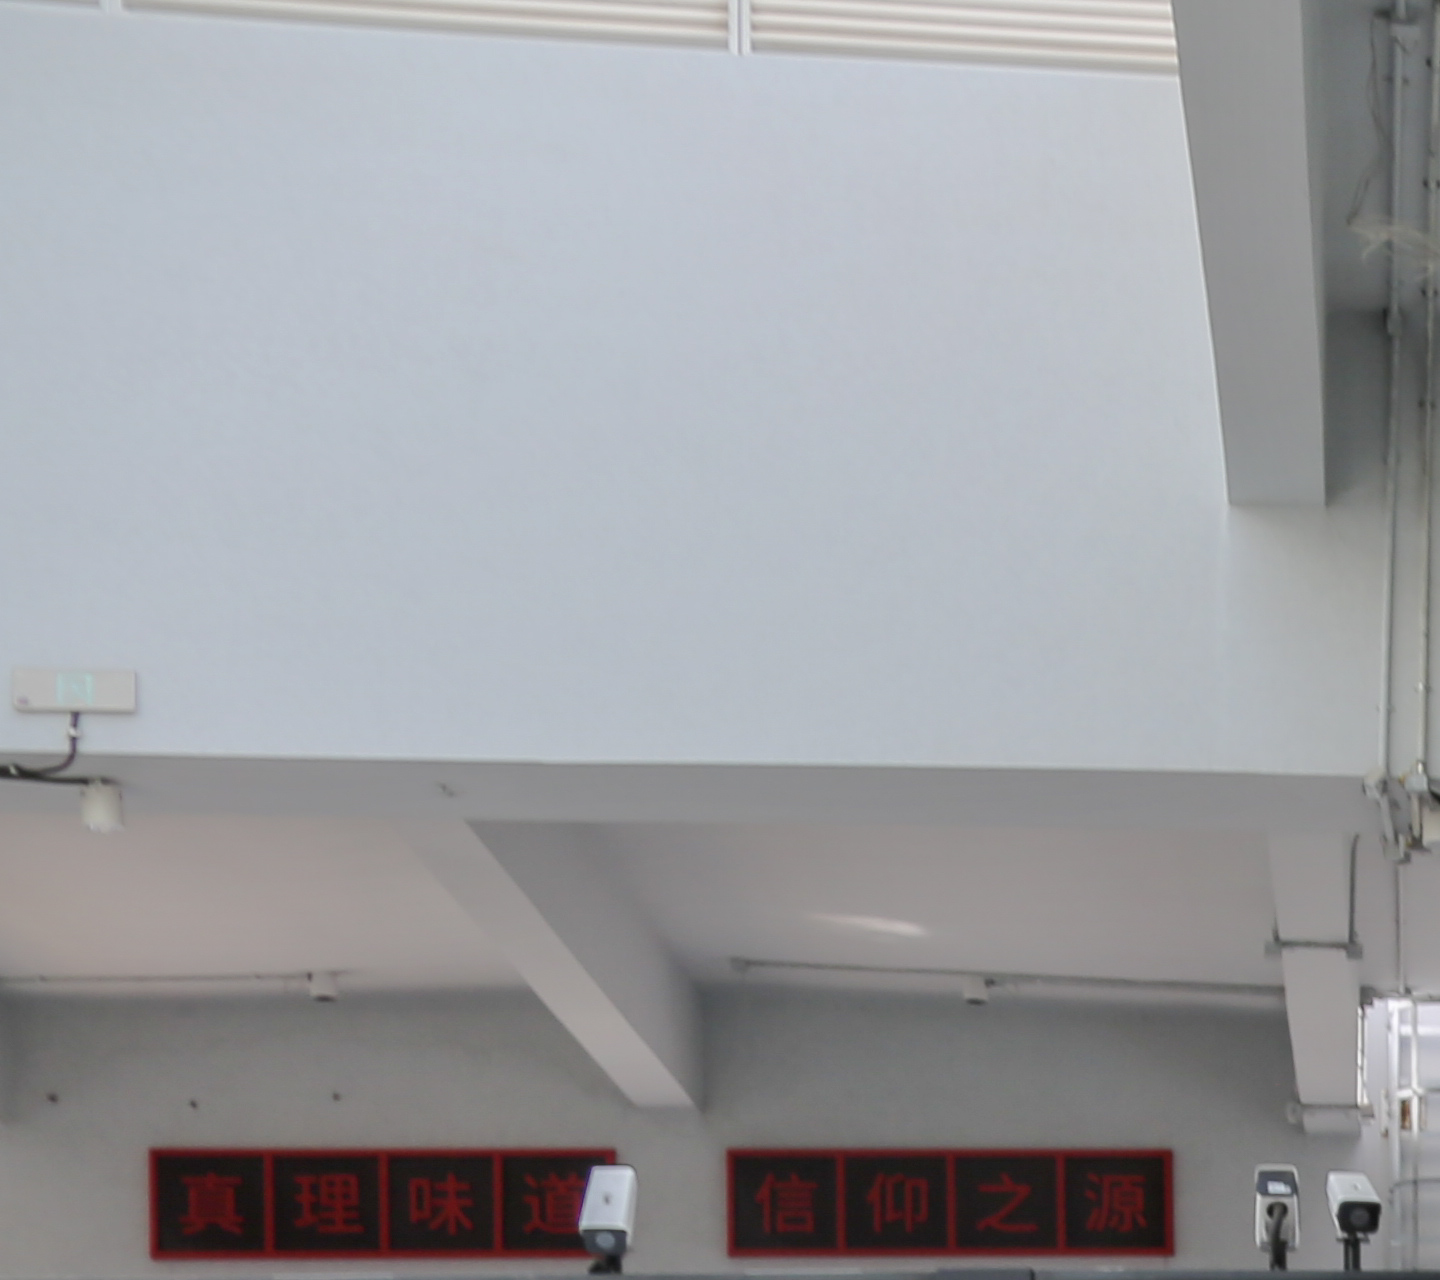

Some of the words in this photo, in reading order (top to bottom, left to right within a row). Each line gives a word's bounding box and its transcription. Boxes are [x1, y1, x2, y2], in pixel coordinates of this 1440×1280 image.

[179, 1172, 584, 1239] 真理味道
[755, 1172, 1148, 1236] 信仰之源
